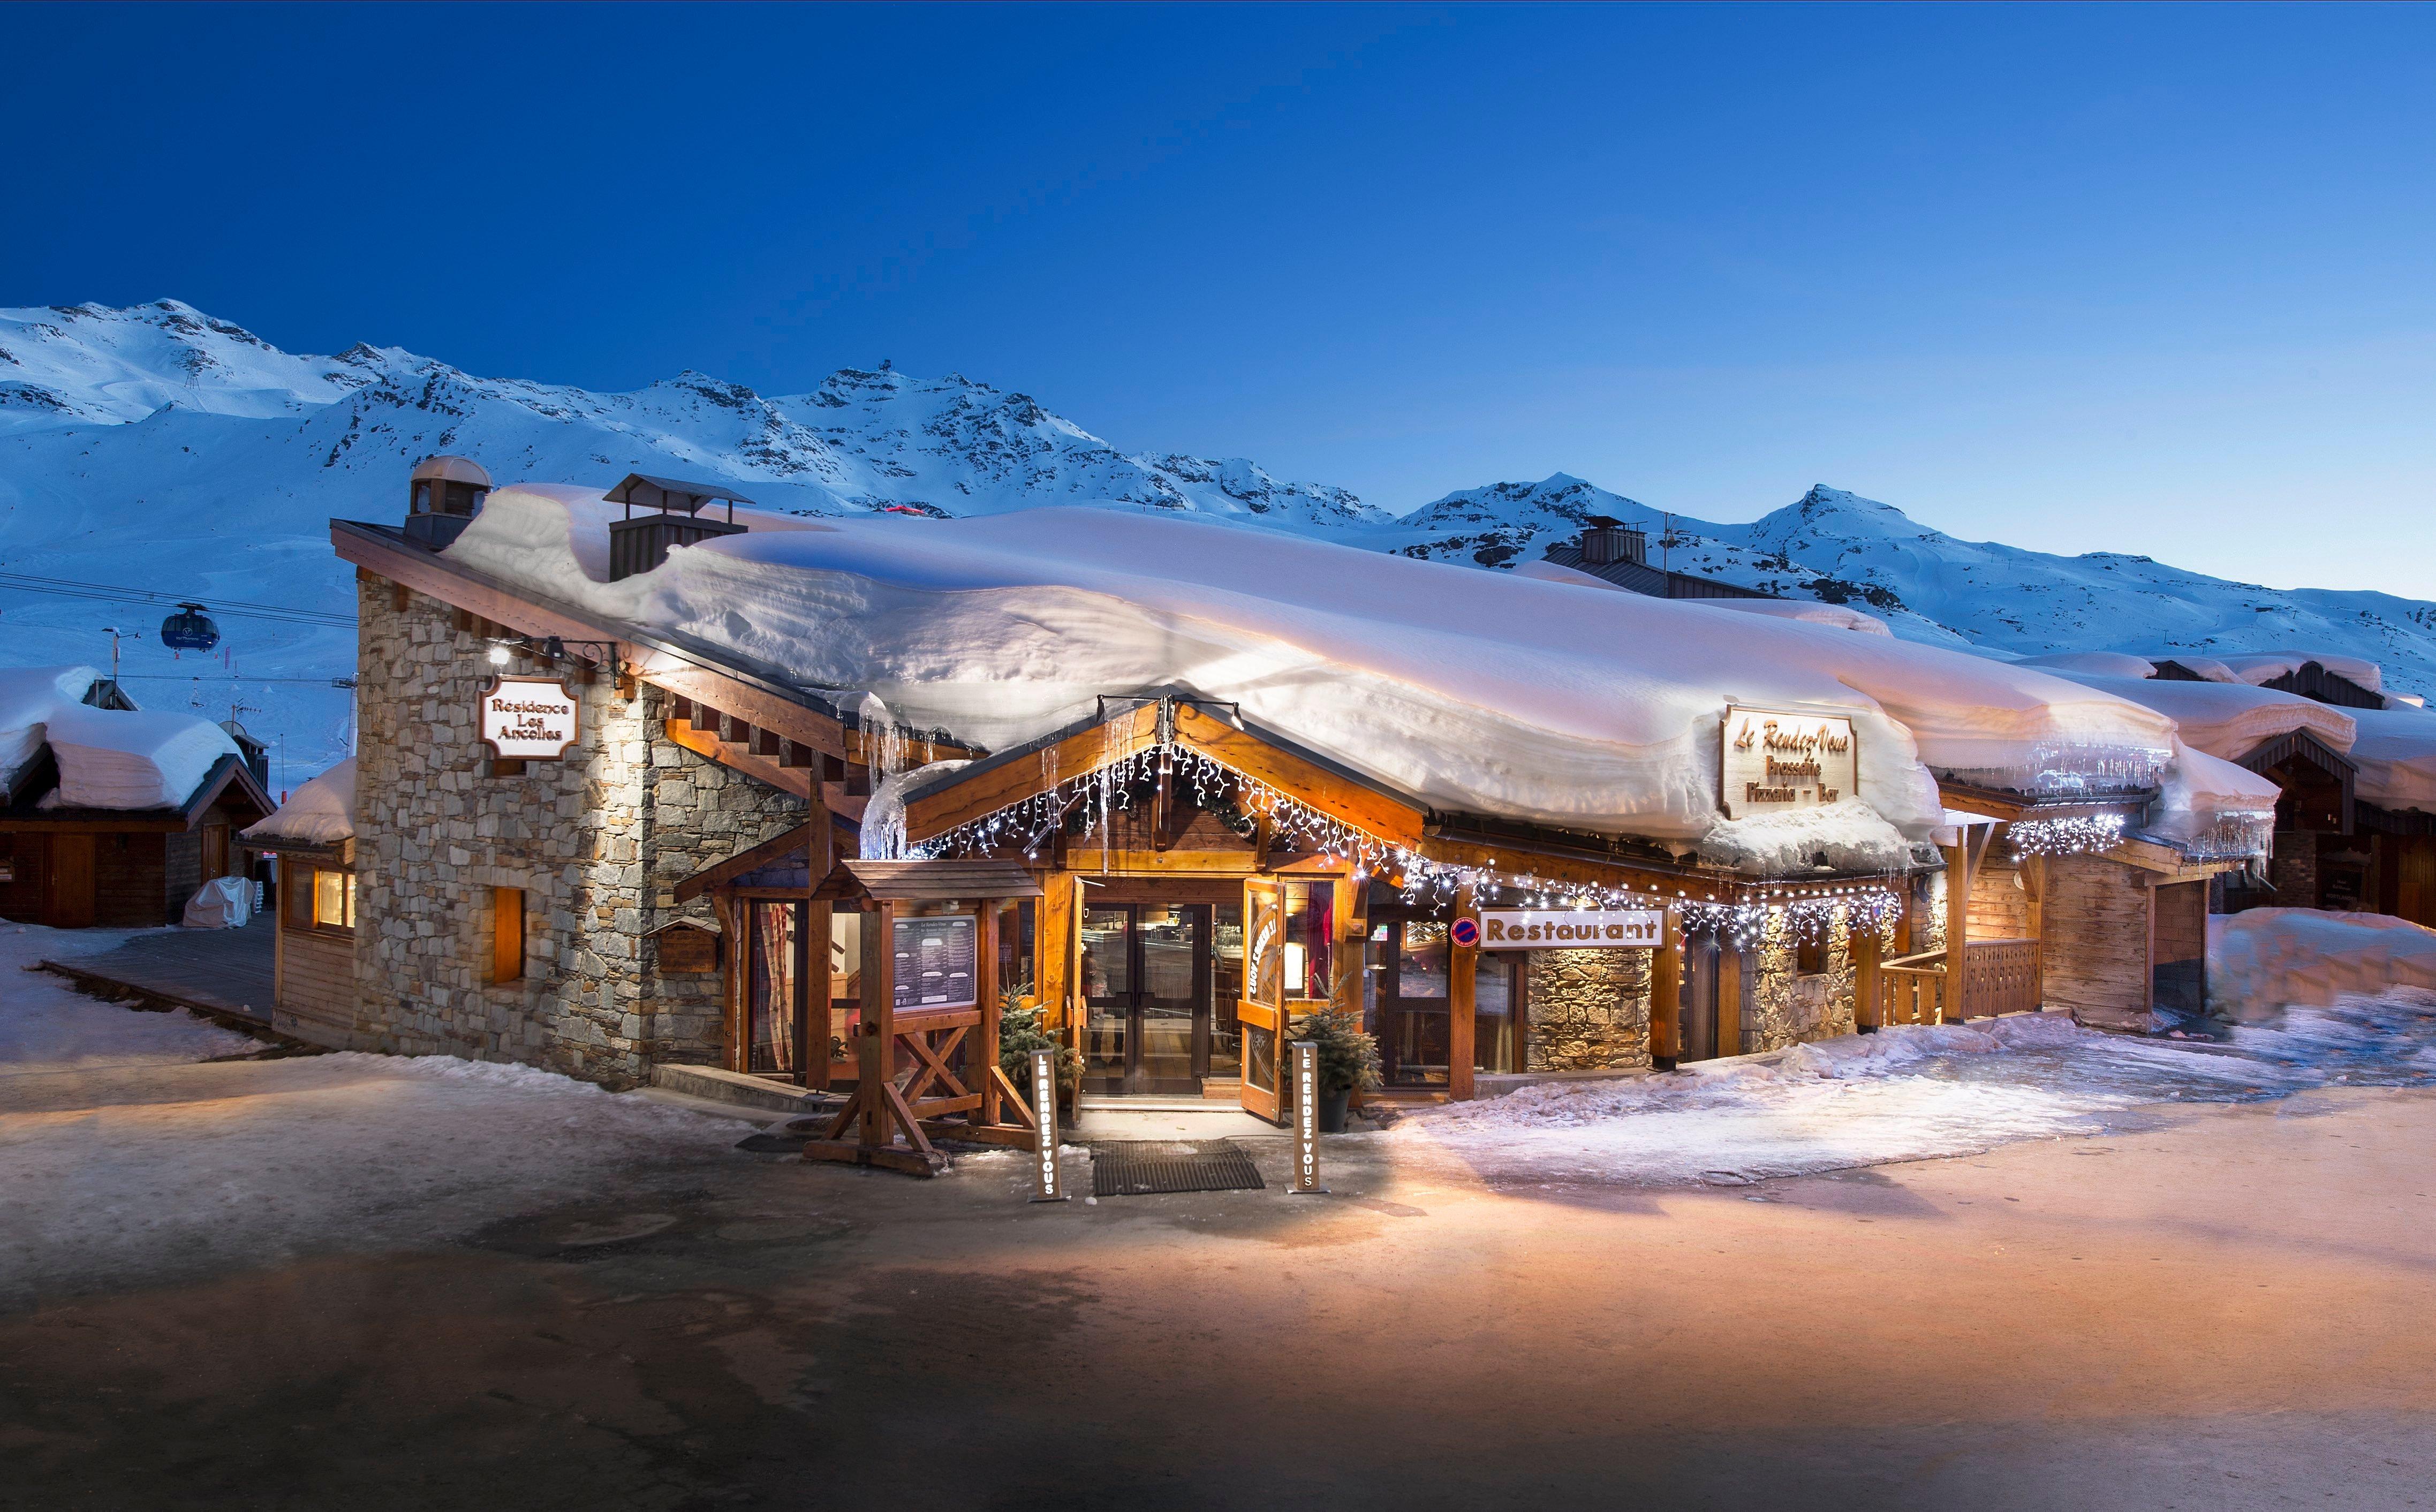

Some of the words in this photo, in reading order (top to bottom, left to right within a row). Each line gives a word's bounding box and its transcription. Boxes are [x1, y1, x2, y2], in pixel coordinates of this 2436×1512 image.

[492, 698, 569, 716] Résidence
[517, 714, 545, 728] Les
[498, 725, 563, 742] Ancolies
[1734, 717, 1755, 748] Le
[1766, 755, 1821, 776] Brasserie
[1746, 782, 1796, 802] Pizzeria
[1818, 783, 1839, 802] Bar
[1487, 919, 1656, 941] Restaurant
[1038, 1054, 1047, 1076] LE
[1303, 1048, 1311, 1069] LE
[1039, 1078, 1051, 1147] RENDEZ
[1302, 1072, 1312, 1139] RENDEZ
[1042, 1150, 1054, 1195] VOUS
[1303, 1143, 1313, 1186] VOUS
